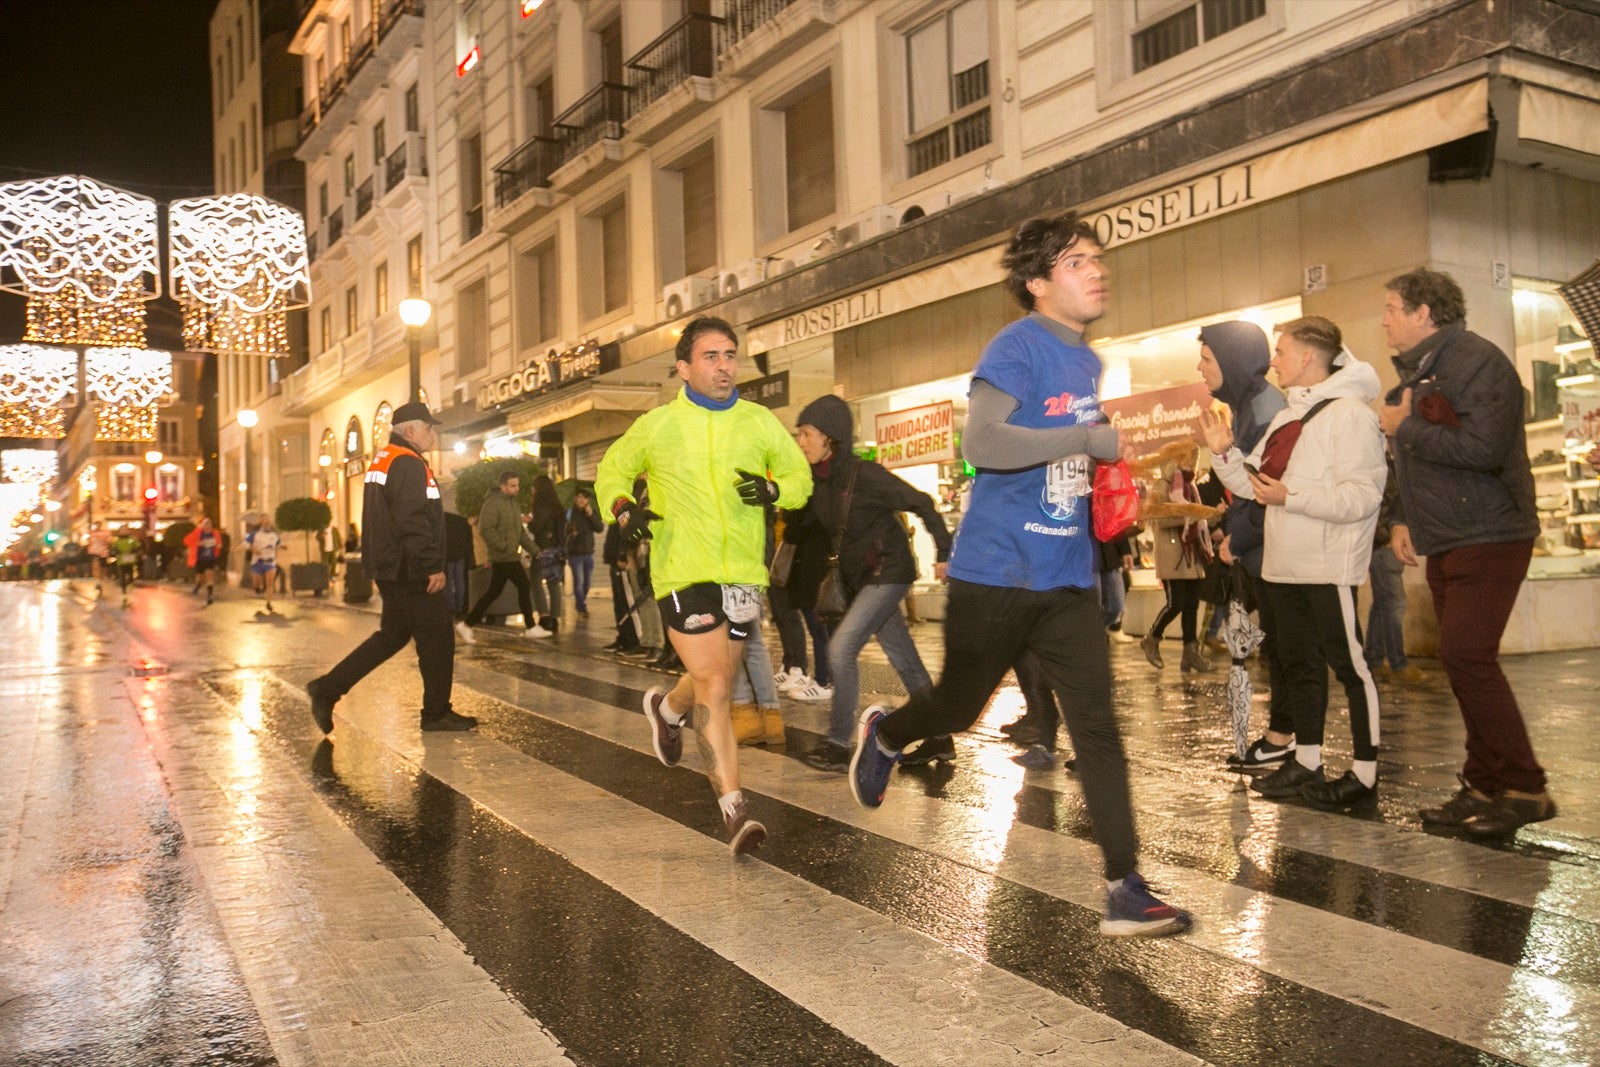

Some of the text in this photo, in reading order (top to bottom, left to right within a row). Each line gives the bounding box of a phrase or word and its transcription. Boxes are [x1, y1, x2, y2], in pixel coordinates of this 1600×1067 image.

[1083, 163, 1257, 248] OSSELLI
[784, 287, 884, 343] ROSSELLI
[878, 406, 951, 446] LIQUIDACIÓN
[880, 431, 948, 464] POR CIERRE
